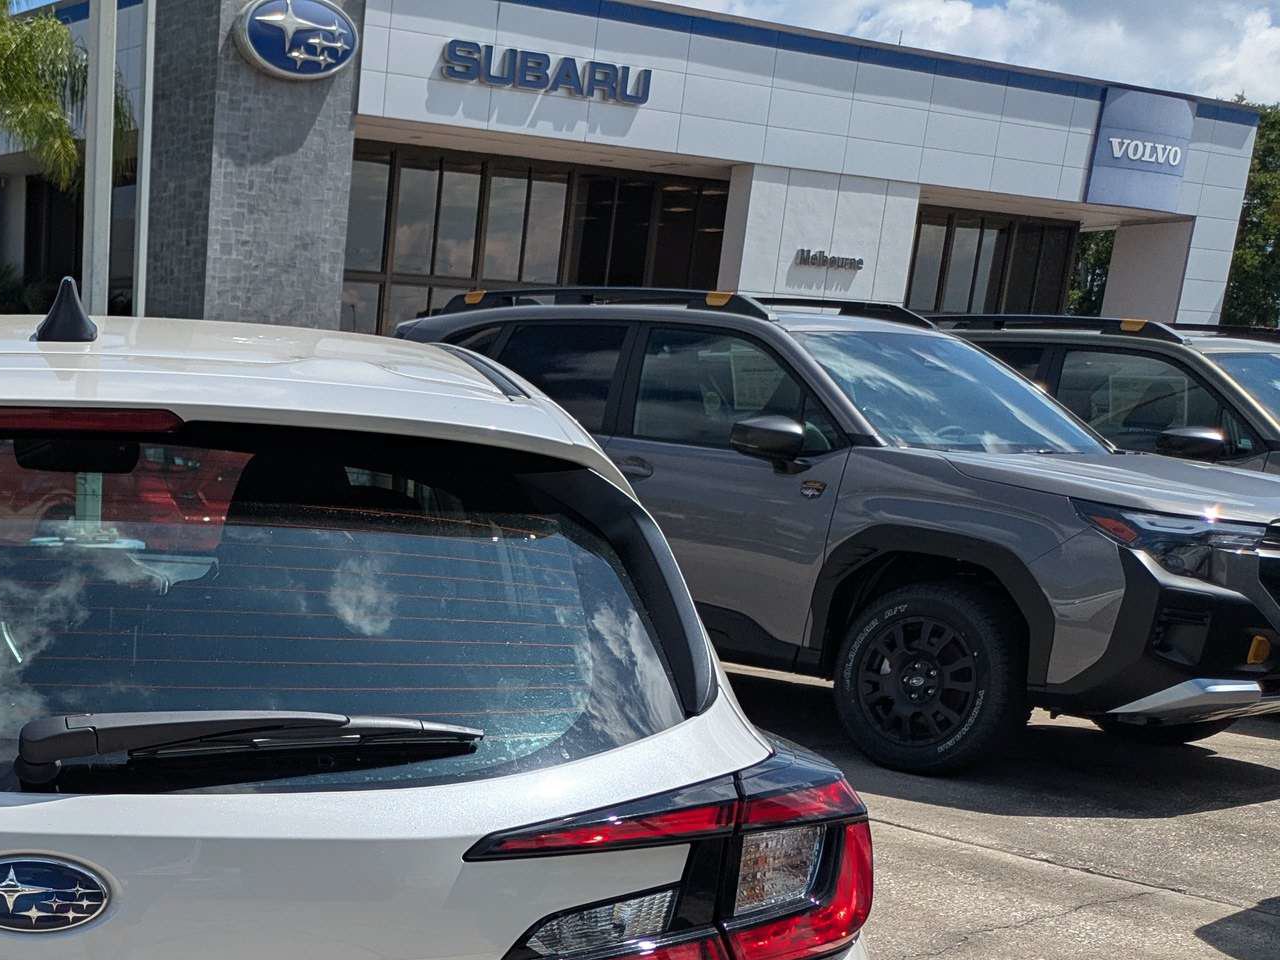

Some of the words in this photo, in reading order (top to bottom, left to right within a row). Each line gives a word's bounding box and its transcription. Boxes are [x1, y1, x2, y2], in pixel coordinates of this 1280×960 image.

[441, 38, 653, 105] SUBARU
[1109, 137, 1182, 166] VOLVO
[796, 248, 864, 271] Melbourne
